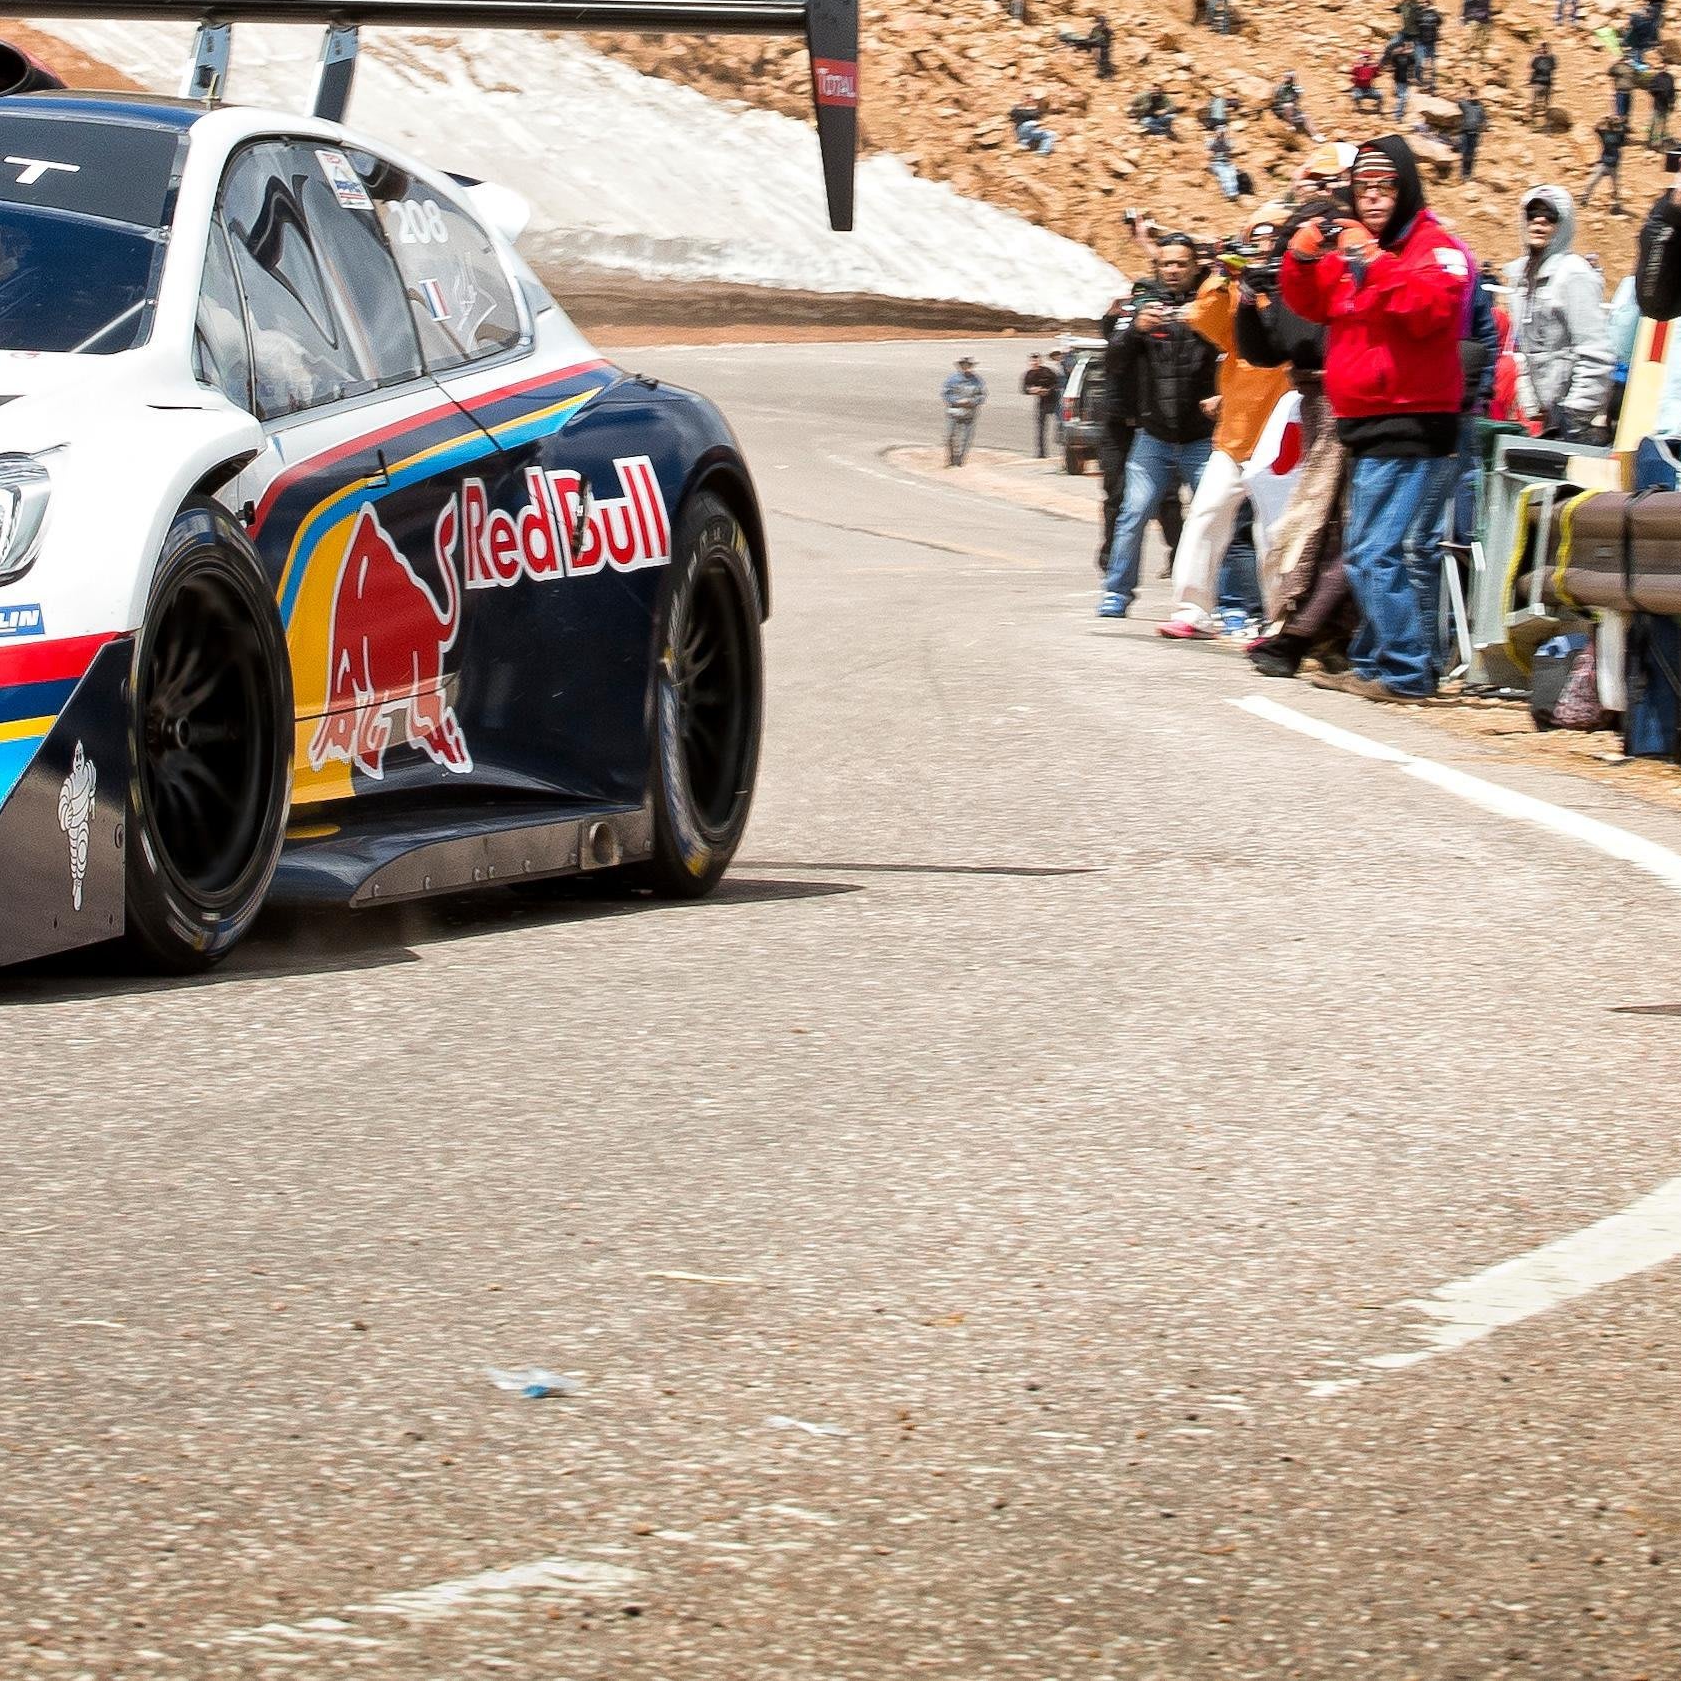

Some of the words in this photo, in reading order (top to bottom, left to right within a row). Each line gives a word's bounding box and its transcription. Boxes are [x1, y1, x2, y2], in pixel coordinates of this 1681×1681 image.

[385, 200, 448, 243] 208
[463, 466, 565, 589] Red
[546, 455, 671, 577] Bull
